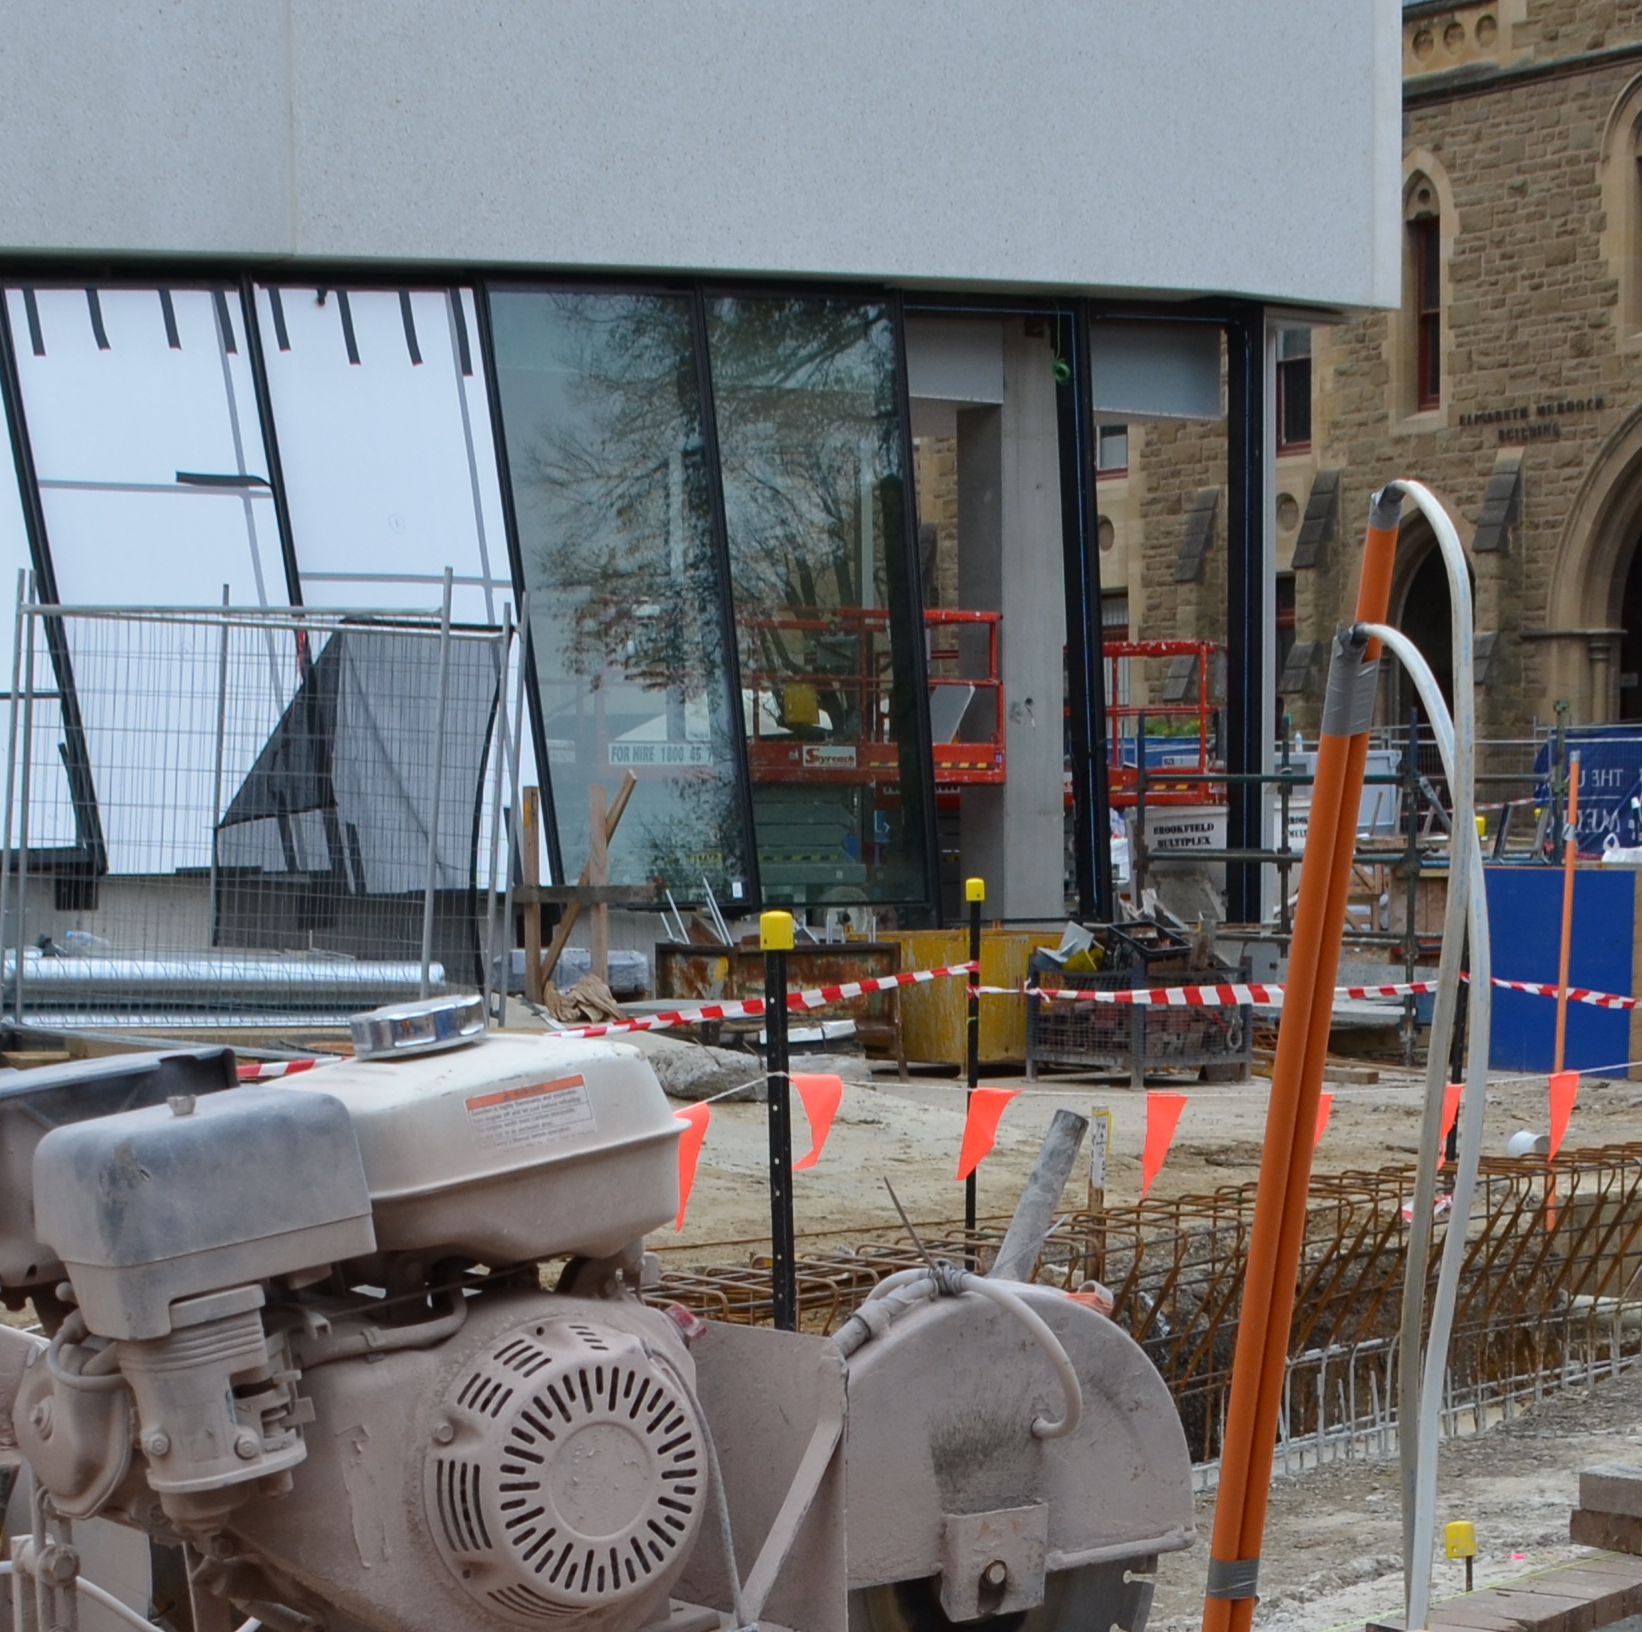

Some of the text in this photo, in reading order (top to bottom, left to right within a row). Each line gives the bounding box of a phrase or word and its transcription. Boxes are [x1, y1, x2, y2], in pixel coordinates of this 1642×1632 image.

[611, 746, 630, 762] FOR
[632, 746, 655, 762] HIRE
[661, 746, 684, 762] 1800
[1153, 823, 1215, 835] BROOKFIELD
[1157, 836, 1212, 848] MULTIPLEX
